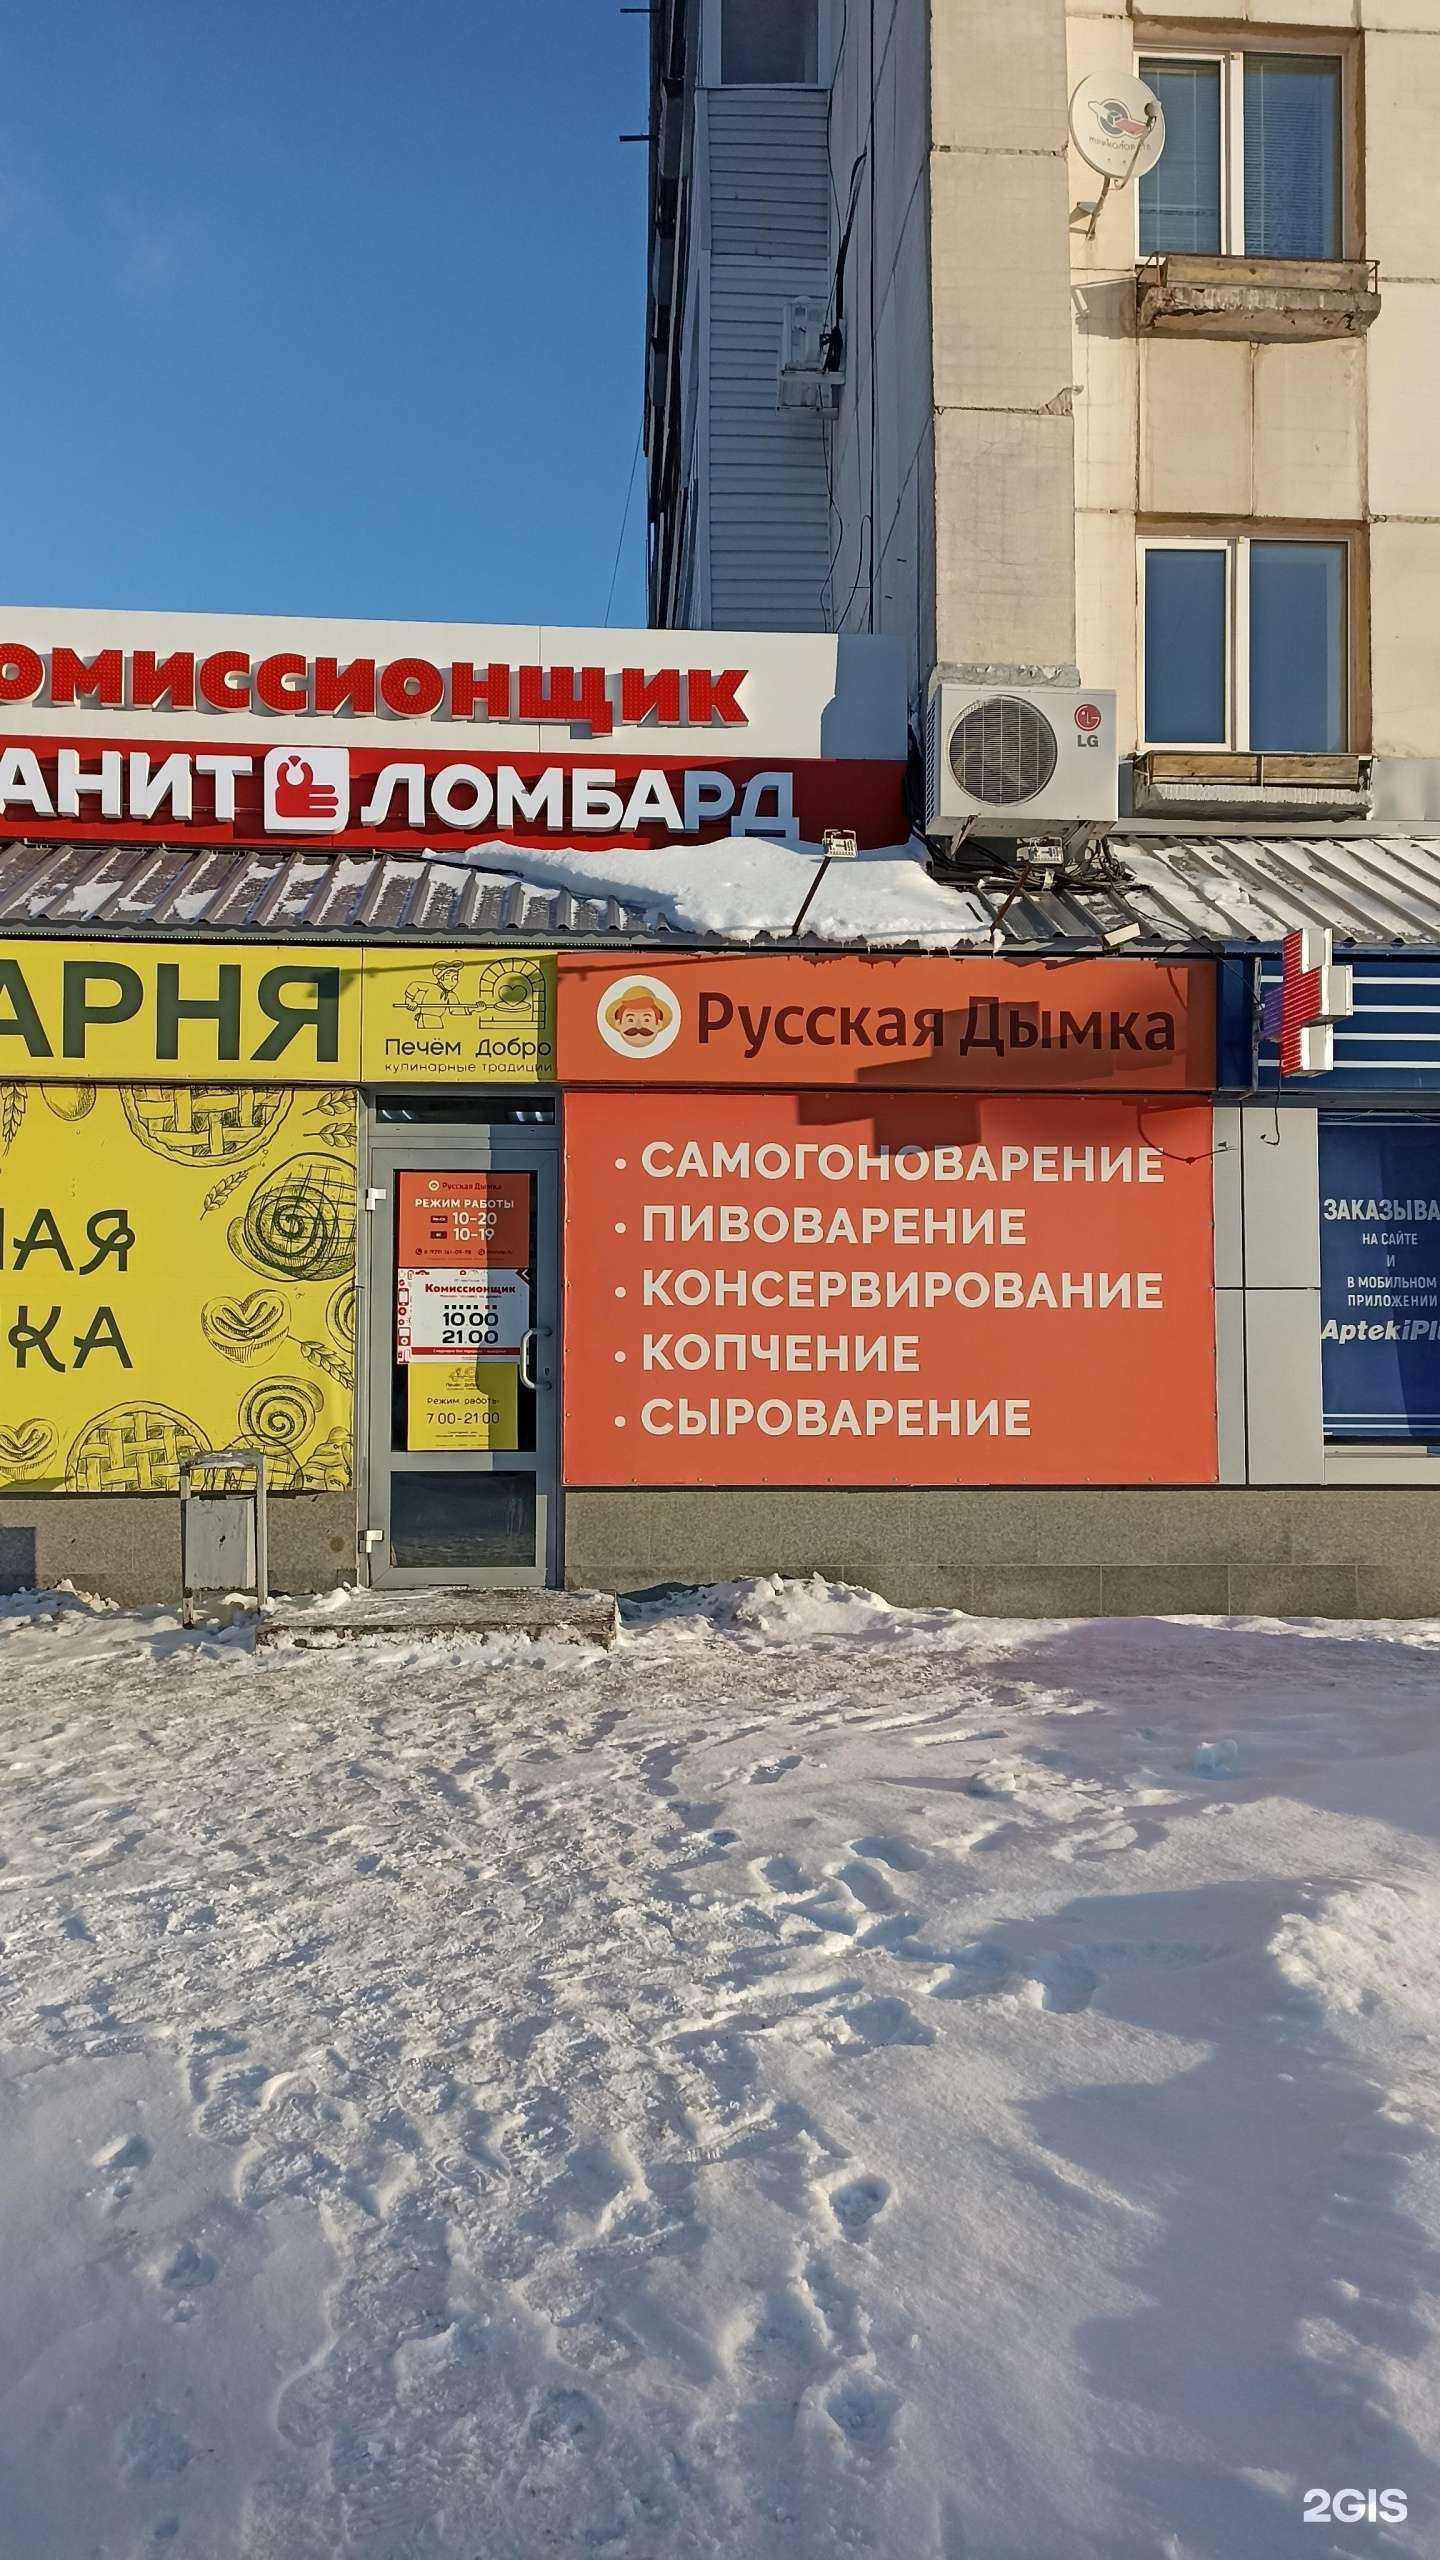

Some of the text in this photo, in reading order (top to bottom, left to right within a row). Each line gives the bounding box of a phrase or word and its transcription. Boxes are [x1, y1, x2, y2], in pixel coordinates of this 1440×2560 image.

[0, 643, 750, 736] ОМИССИОНЩИК
[1077, 734, 1099, 748] LG
[0, 747, 801, 837] АНИТ ЛОМБАРД
[697, 991, 1177, 1059] Русская Дымка
[385, 1037, 552, 1059] Печём Добро
[385, 1063, 552, 1073] кулинарные традиции
[641, 1140, 1166, 1184] САМОГОНОВАРЕНИЕ
[415, 1198, 514, 1209] РЕЖИМ РАБОТЫ
[1323, 1198, 1440, 1222] ЗАКАЗЫВА
[452, 1211, 498, 1226] 10-20
[641, 1205, 1027, 1246] ПИВОВАРЕНИЕ
[453, 1227, 495, 1241] 10-19
[1362, 1231, 1419, 1246] НА САЙТЕ
[1385, 1253, 1397, 1268] И
[424, 1283, 516, 1294] Комиссионщик
[641, 1269, 1165, 1310] КОНСЕРВИРОВАНИЕ
[1346, 1275, 1437, 1289] В МОБИЛЬНОМ
[1347, 1294, 1439, 1308] ПРИЛОЖЕНИИ
[7, 1305, 134, 1373] КА
[1321, 1319, 1440, 1345] AptekiPl
[641, 1333, 921, 1373] КОПЧЕНИЕ
[427, 1397, 460, 1405] Режим
[641, 1398, 1032, 1437] СЫРОВАРЕНИЕ
